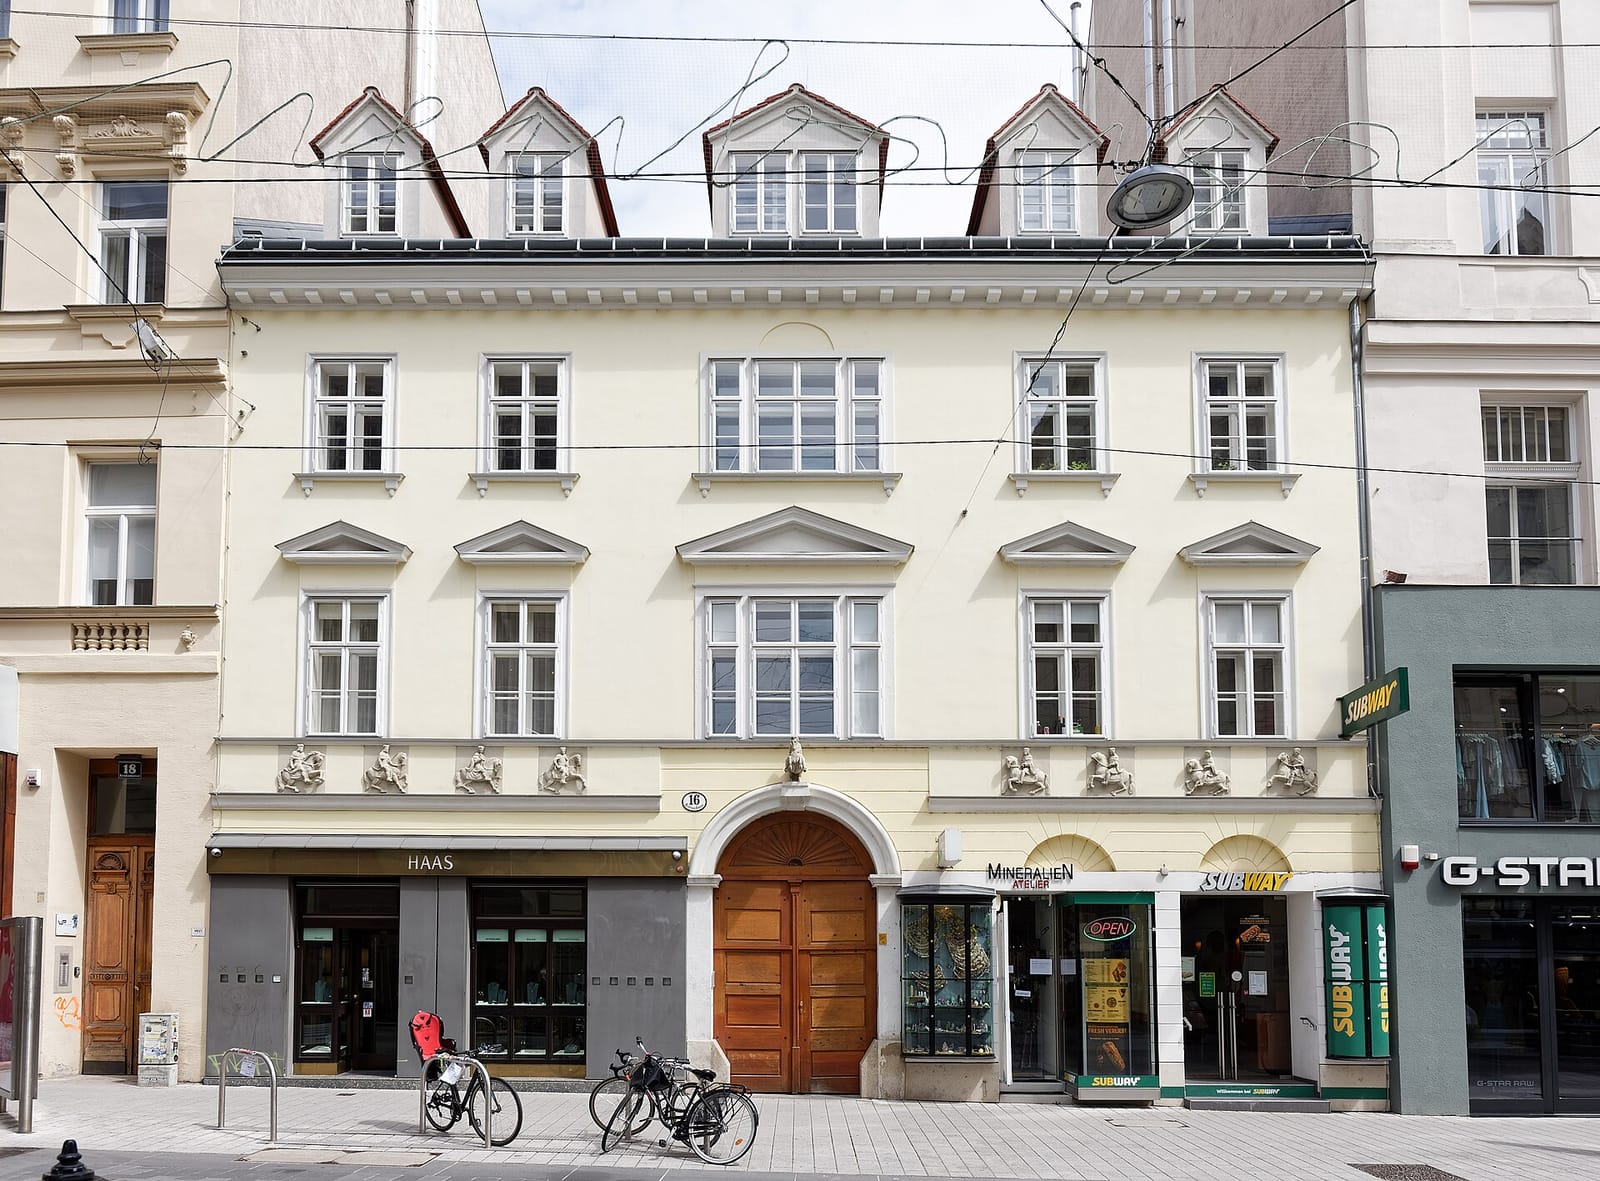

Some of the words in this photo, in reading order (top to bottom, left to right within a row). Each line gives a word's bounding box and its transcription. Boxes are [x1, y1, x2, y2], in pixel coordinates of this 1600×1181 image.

[1345, 680, 1398, 725] SUBWAY
[122, 763, 137, 775] 18
[689, 794, 700, 805] 16
[408, 855, 454, 870] HAAS
[988, 863, 1073, 880] MINERALIEN
[1443, 856, 1600, 887] G-STA
[1012, 879, 1050, 889] ATELIER
[1200, 871, 1293, 892] SUBWAY
[1090, 922, 1129, 935] OPEN
[1328, 923, 1356, 1037] SUBWAY
[1091, 1076, 1141, 1086] SUBWAY
